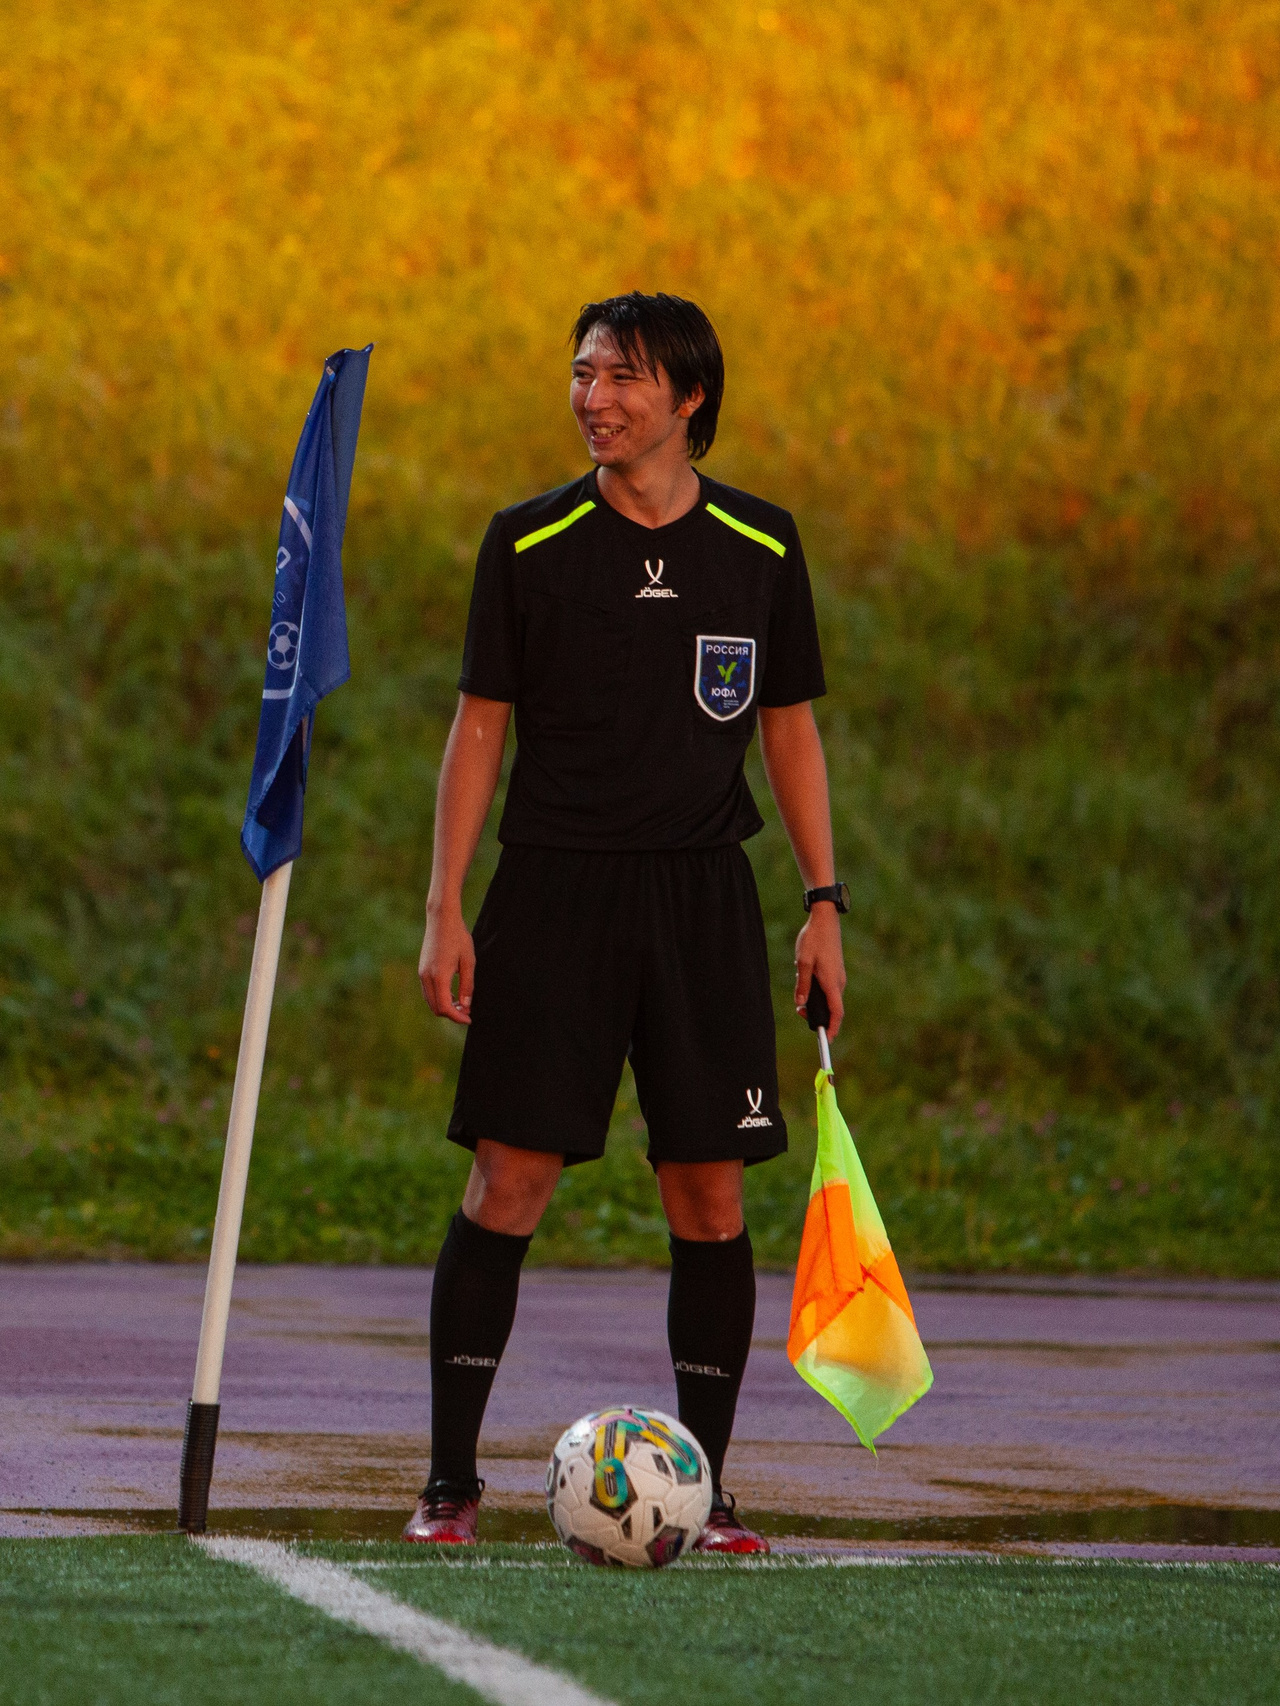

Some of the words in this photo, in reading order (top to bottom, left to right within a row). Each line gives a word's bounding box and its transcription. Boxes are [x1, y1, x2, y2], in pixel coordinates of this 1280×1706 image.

[635, 586, 679, 598] JÖGEL
[706, 644, 749, 656] РОССИЯ
[711, 687, 737, 698] ЮФЛ
[737, 1116, 773, 1129] JÖGEL
